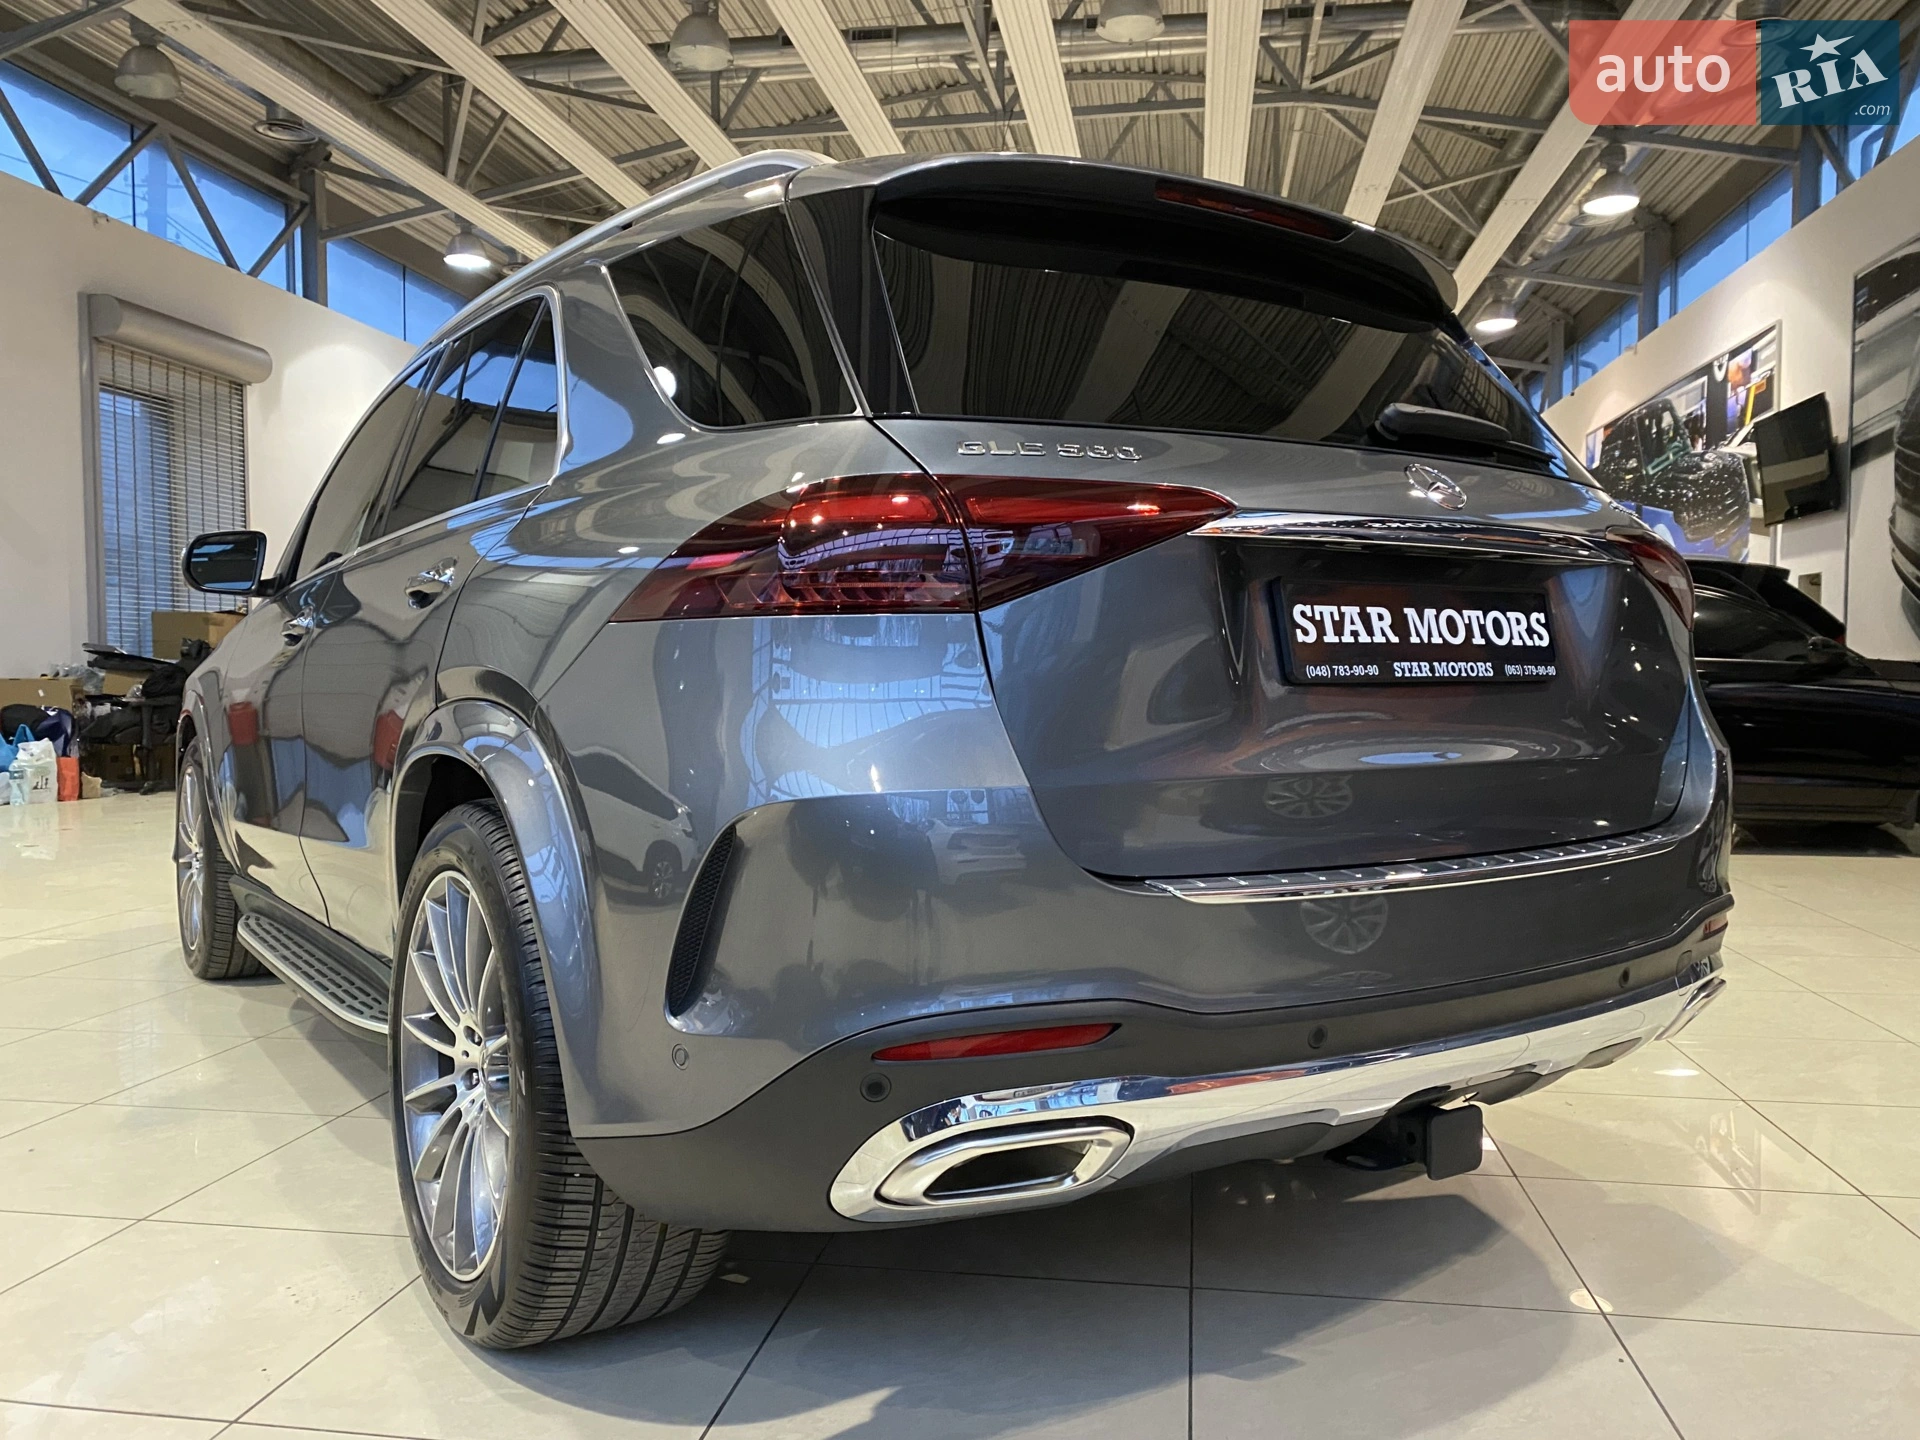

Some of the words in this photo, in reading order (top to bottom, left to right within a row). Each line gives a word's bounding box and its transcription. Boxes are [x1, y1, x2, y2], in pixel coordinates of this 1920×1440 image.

[958, 441, 1046, 456] GLE
[1292, 603, 1399, 644] STAR
[1403, 607, 1550, 648] MOTORS
[1306, 664, 1331, 679] (048)
[1332, 664, 1379, 677] 783-90-90
[1393, 661, 1433, 677] STAR
[1433, 661, 1494, 677] MOTORS
[1504, 664, 1523, 676] (063)
[1524, 664, 1557, 676] 379-90-90
